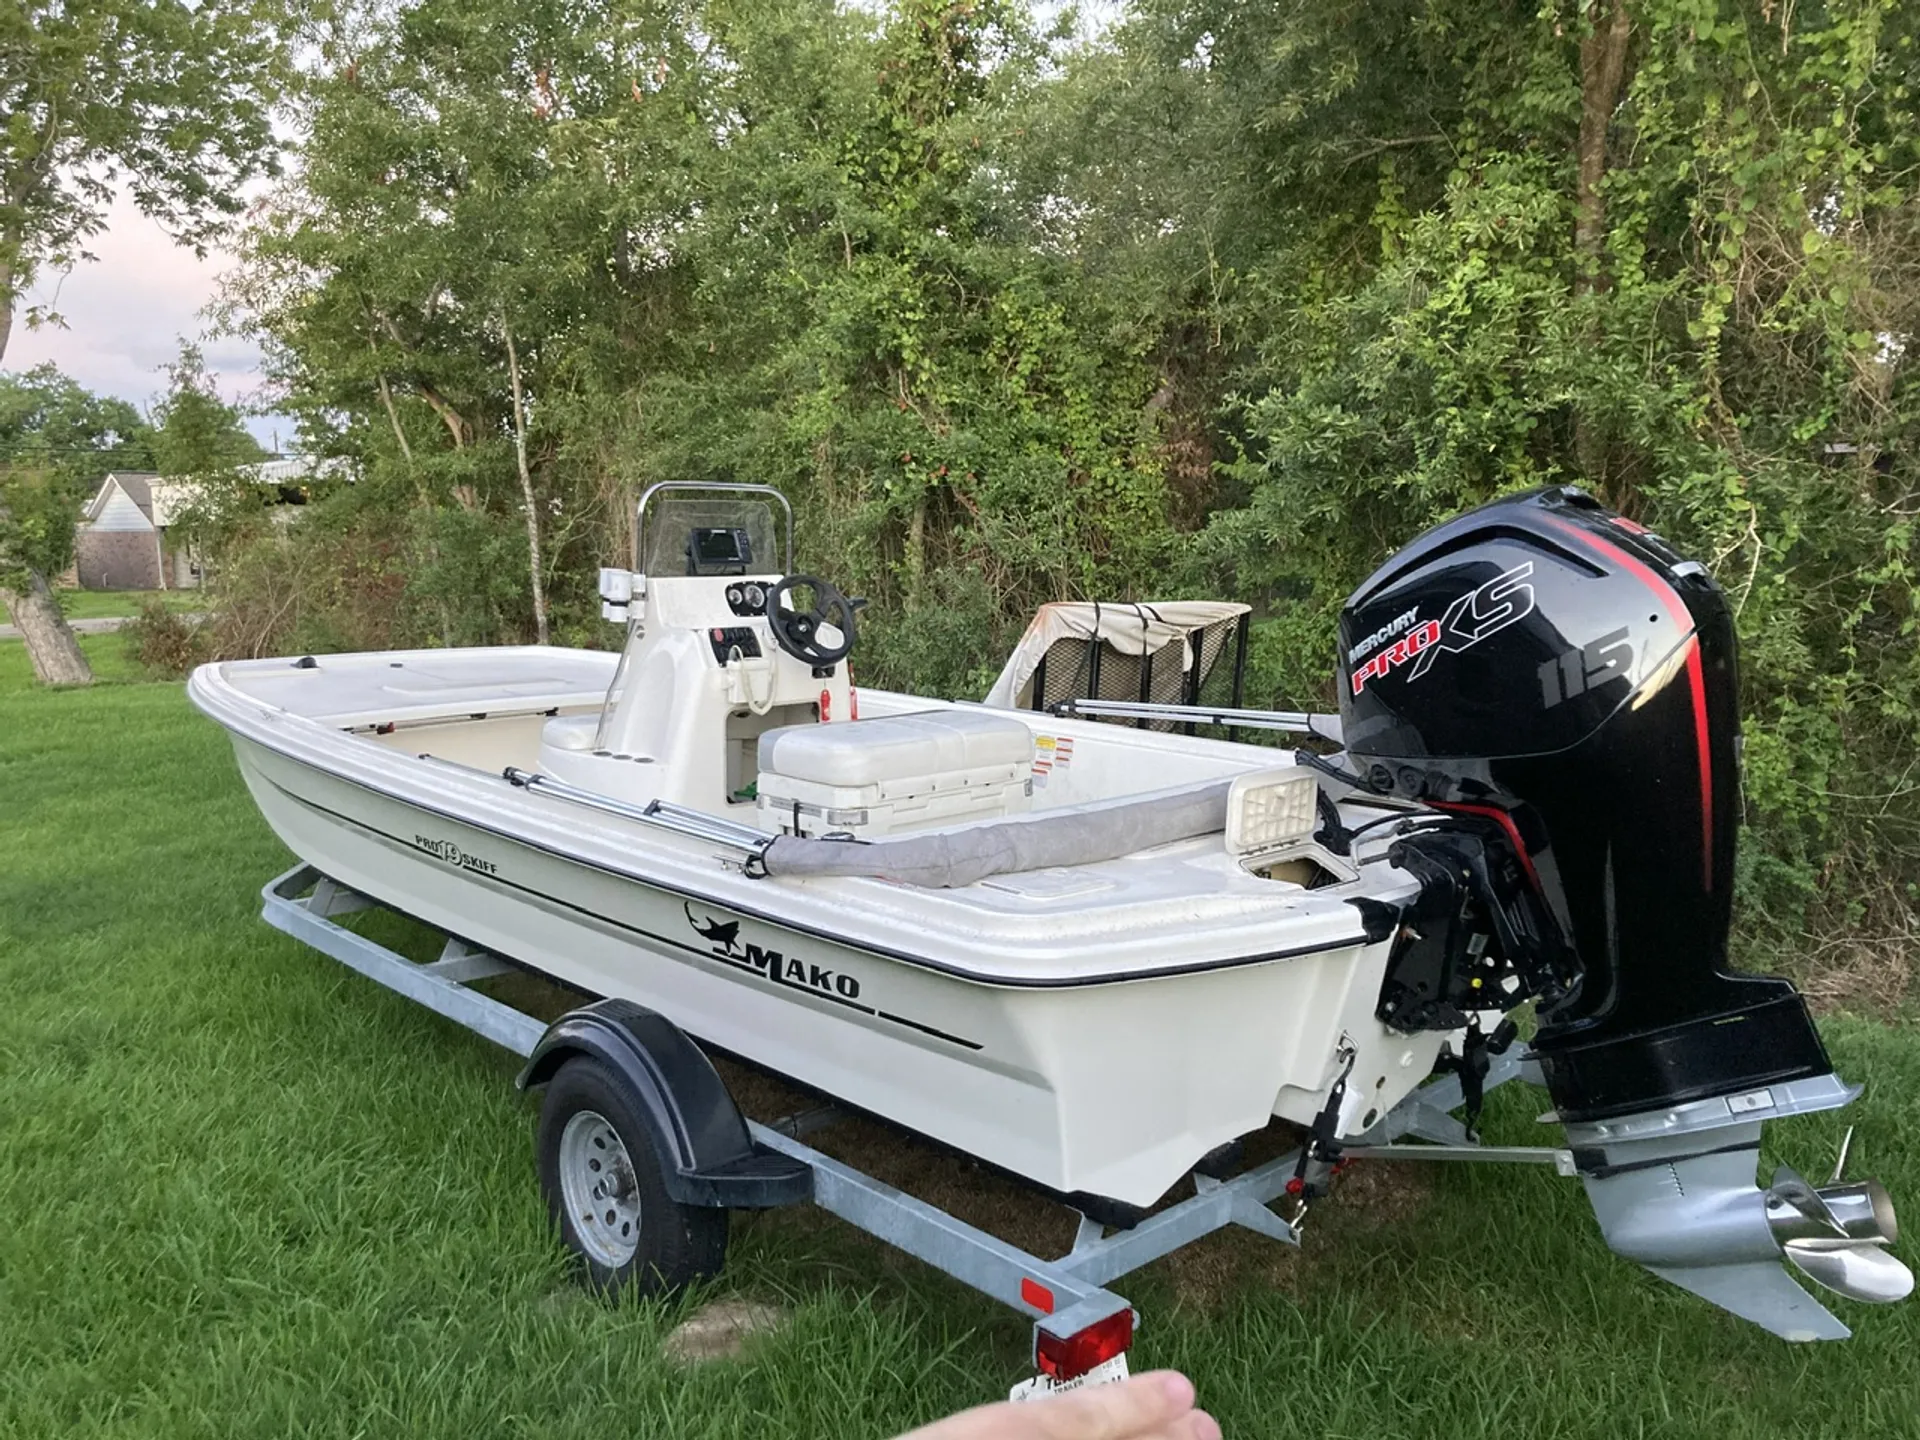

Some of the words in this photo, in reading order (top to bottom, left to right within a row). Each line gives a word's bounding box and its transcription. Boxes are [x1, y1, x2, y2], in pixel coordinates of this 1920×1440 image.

[1349, 606, 1419, 664] MERCURY
[1352, 619, 1441, 696] PRO
[1407, 561, 1535, 683] XS
[1538, 625, 1633, 709] 115
[415, 834, 439, 853] PRO
[437, 840, 462, 866] 19
[462, 854, 497, 873] SKIFF
[744, 943, 861, 999] MAKO
[1054, 1379, 1085, 1395] TRAILER
